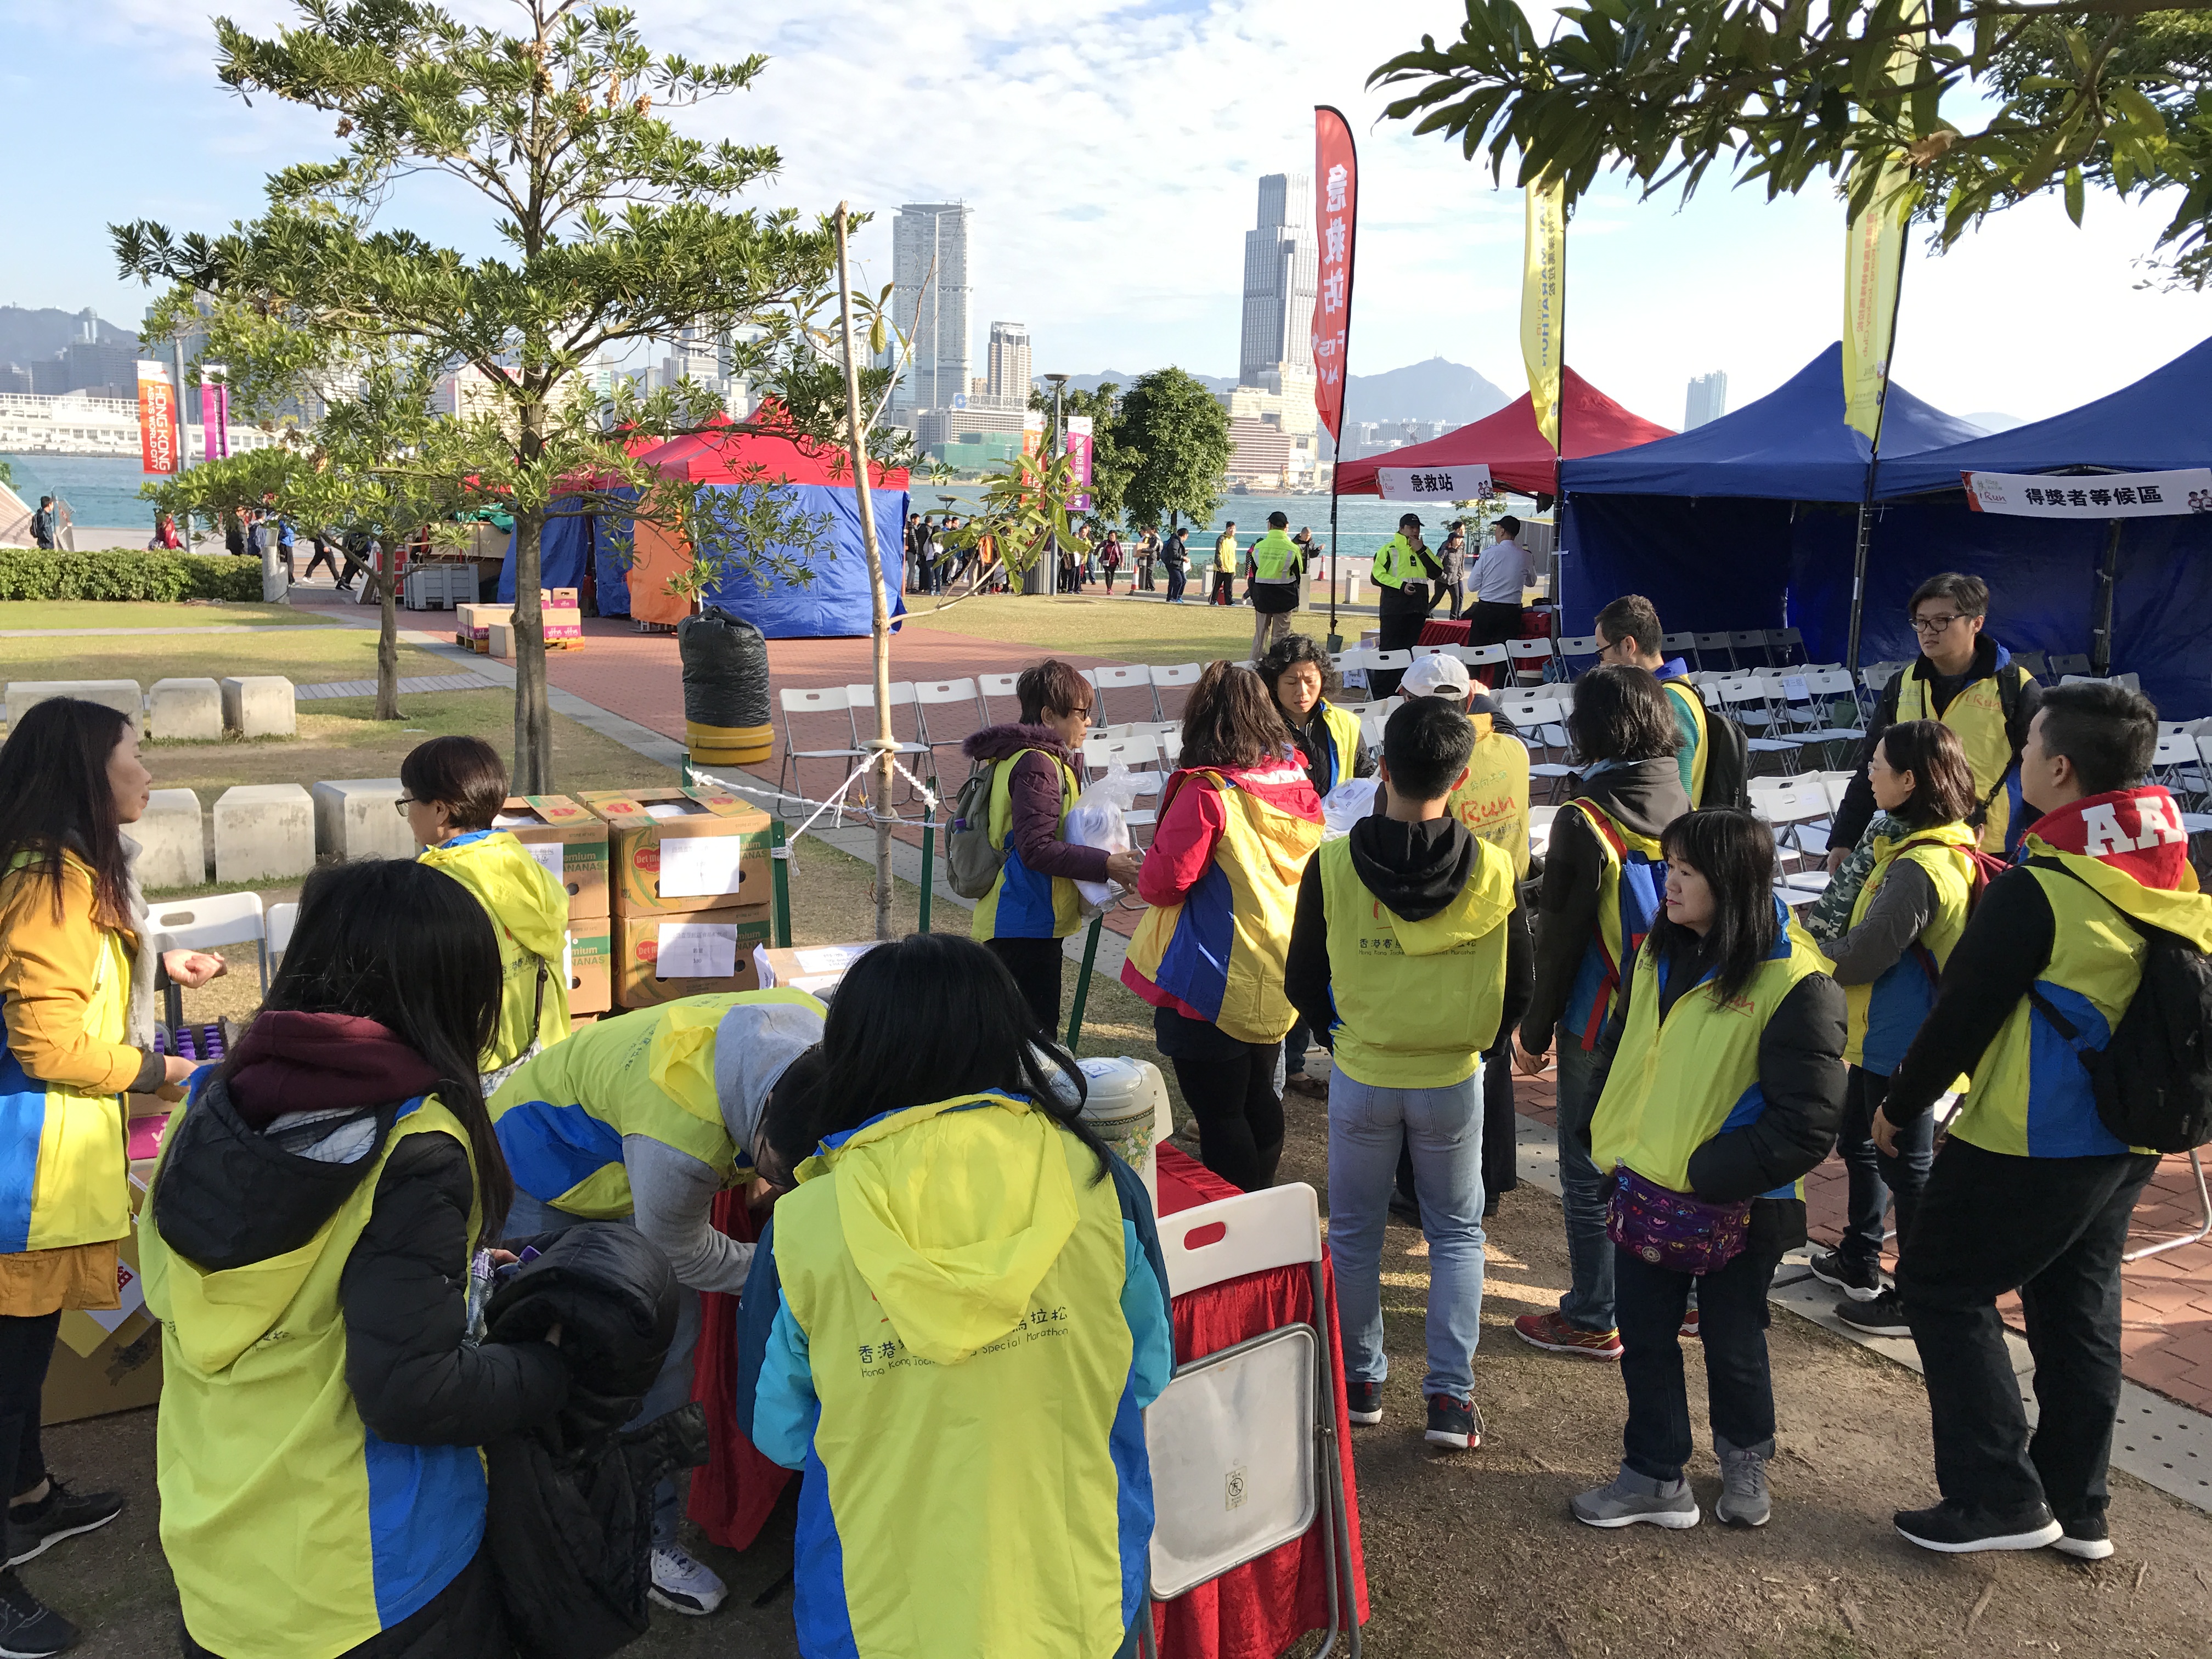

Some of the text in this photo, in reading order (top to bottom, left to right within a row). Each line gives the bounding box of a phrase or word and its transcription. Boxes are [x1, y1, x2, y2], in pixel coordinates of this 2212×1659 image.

[146, 385, 159, 470] ASIA'S WORLD CITY
[155, 385, 171, 471] HONG KONG
[1074, 437, 1085, 507] 香港亞洲國都會
[1410, 473, 1454, 492] 急救站
[2024, 485, 2164, 507] 得獎者等候區
[1460, 796, 1516, 825] Run
[740, 841, 761, 849] mium
[563, 852, 596, 860] emium
[636, 854, 648, 863] Del
[742, 850, 768, 861] ANAS
[563, 862, 603, 872] ANANAS
[737, 931, 760, 940] mium
[571, 946, 598, 955] mium
[637, 946, 650, 955] Del
[572, 956, 605, 967] NANAS
[861, 1368, 885, 1378] Hong
[888, 1358, 911, 1369] Kong
[982, 1336, 1020, 1355] Special
[1026, 1327, 1068, 1343] Marathon
